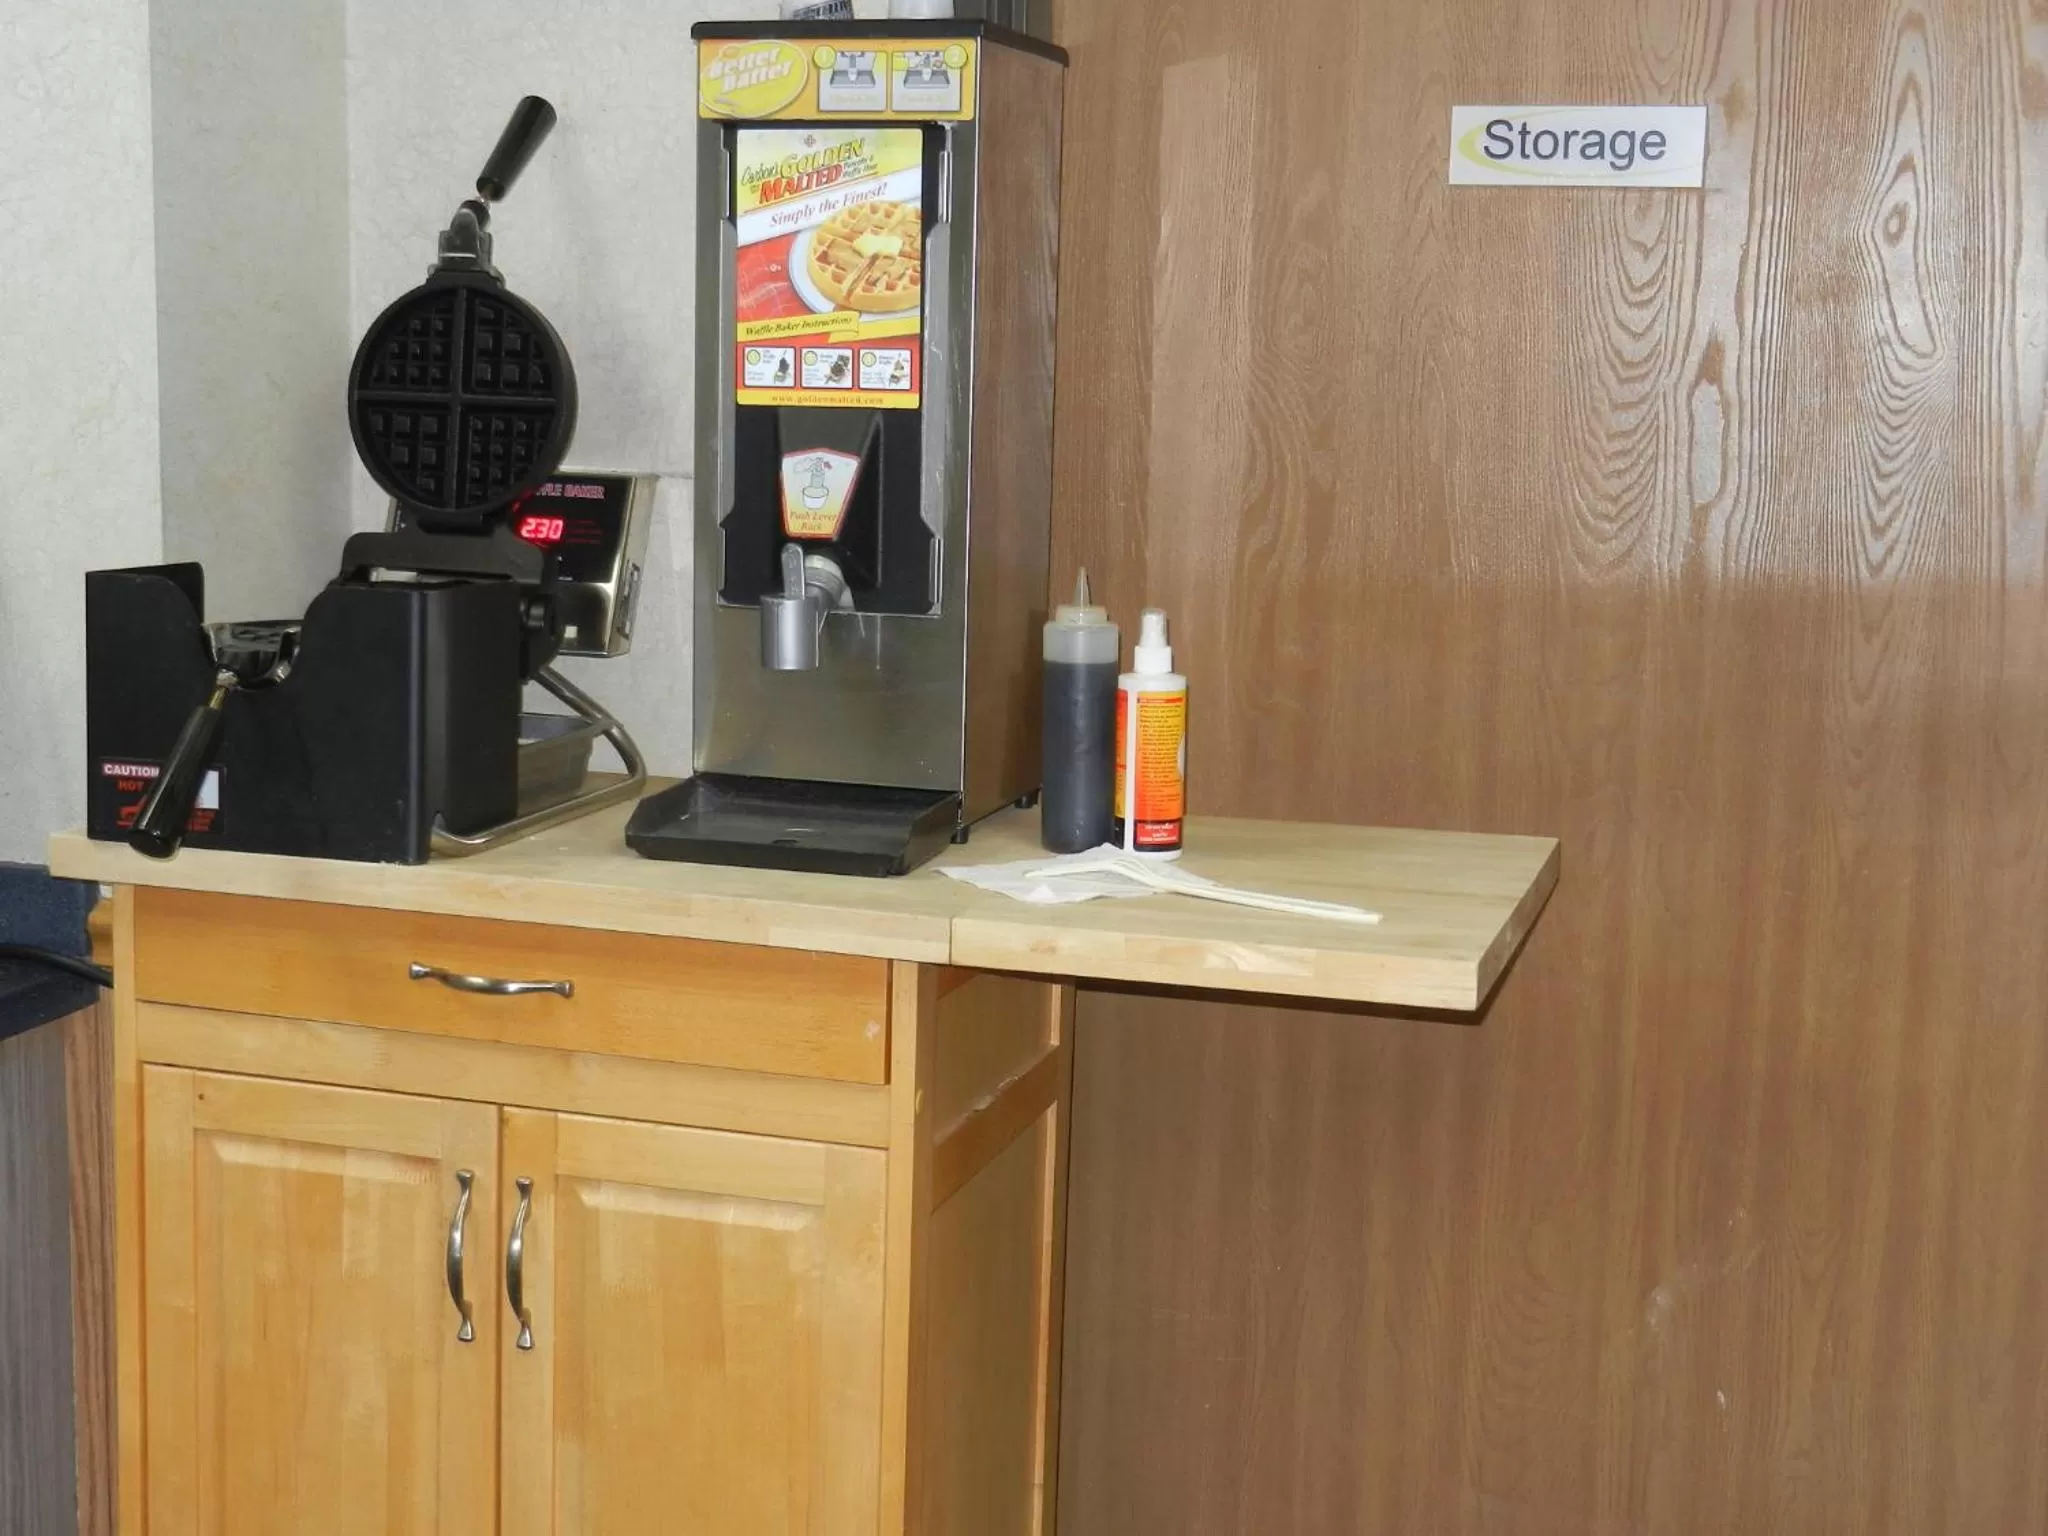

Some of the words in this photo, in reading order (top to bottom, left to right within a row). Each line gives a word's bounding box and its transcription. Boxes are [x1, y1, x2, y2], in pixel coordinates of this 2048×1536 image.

[780, 137, 865, 178] GOLDEN
[1483, 119, 1667, 171] Storage
[759, 163, 843, 204] MALTED
[770, 204, 815, 227] Simply
[819, 198, 840, 214] the
[843, 182, 888, 207] Finest!
[746, 325, 774, 336] Waffle
[775, 322, 800, 333] Baker
[801, 317, 852, 329] Instructions
[520, 517, 564, 540] 230
[103, 763, 160, 777] CAUTION
[119, 780, 144, 792] HOT
